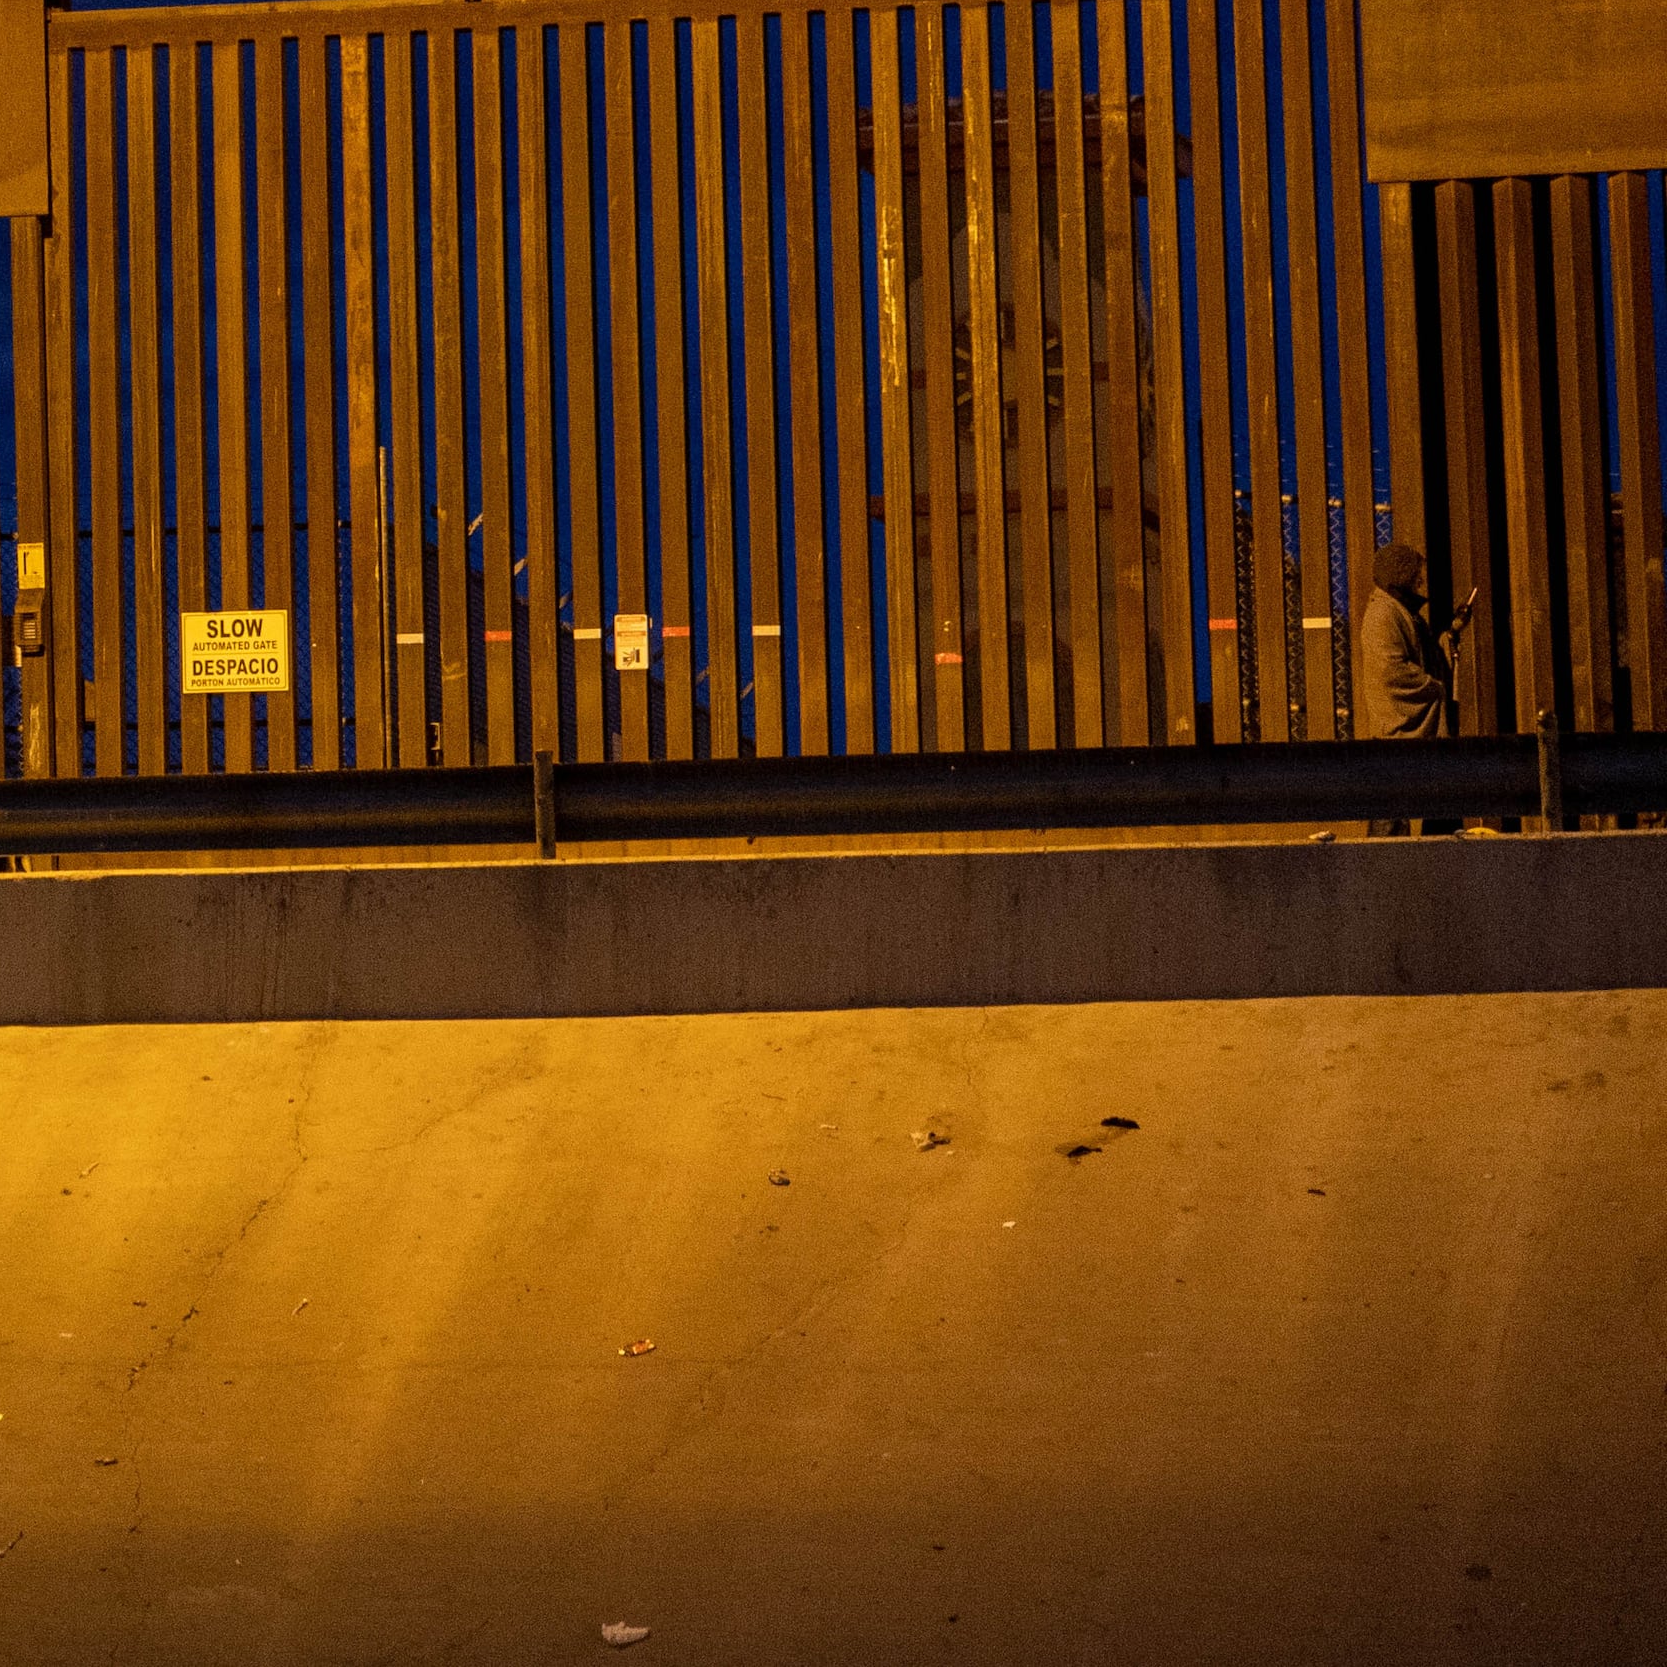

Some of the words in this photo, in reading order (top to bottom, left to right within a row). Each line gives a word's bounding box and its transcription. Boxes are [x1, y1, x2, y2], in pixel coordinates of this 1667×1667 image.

[207, 619, 263, 638] SLOW
[193, 641, 250, 651] AUTOMATED
[253, 640, 278, 650] GATE
[193, 658, 278, 676] DESPACIO
[191, 678, 224, 687] PORTON
